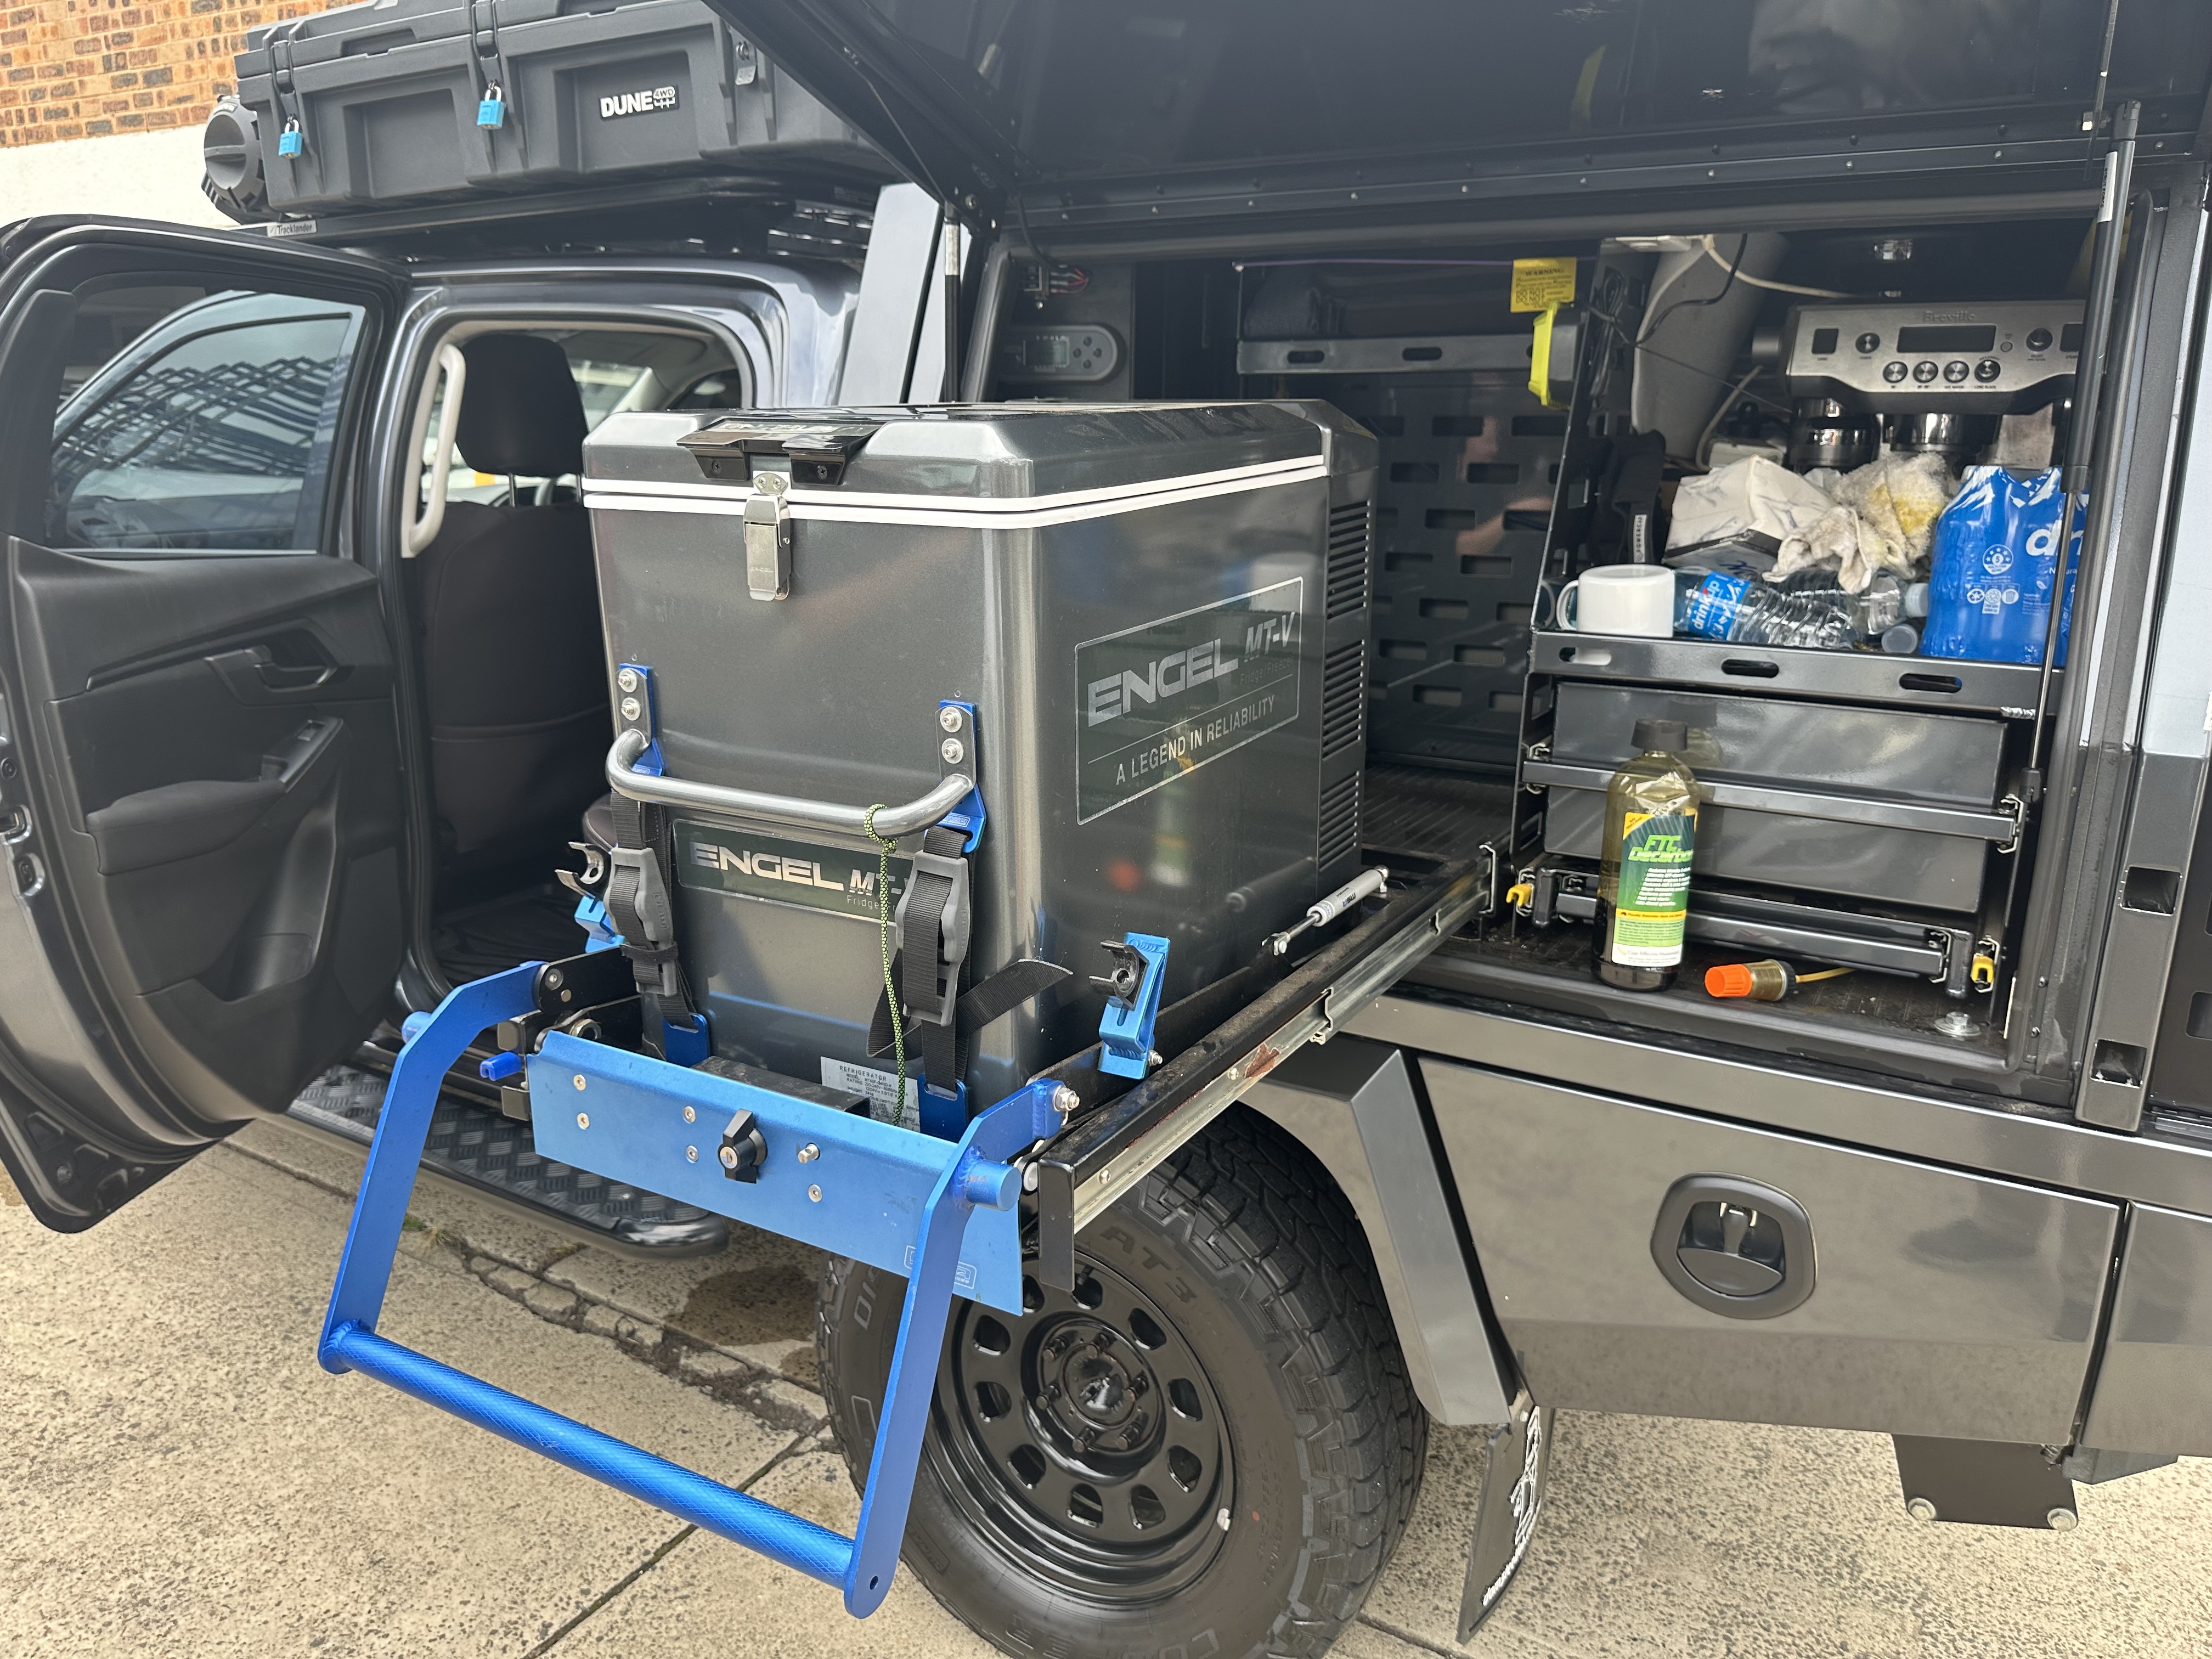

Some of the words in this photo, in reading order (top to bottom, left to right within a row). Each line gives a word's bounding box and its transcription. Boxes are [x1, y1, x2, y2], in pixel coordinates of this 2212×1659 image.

[600, 91, 654, 117] DUNE
[654, 88, 674, 98] 4WD
[277, 223, 313, 235] Tracklander
[1923, 309, 1976, 323] Breville
[1088, 638, 1238, 727] ENGEL
[1245, 611, 1295, 655] MT-V
[1116, 763, 1126, 786] A
[1131, 736, 1186, 778] LEGEND
[1190, 728, 1203, 751] IN
[1207, 695, 1274, 743] RELIABILITY
[1644, 834, 1681, 851] FTC
[690, 841, 844, 891] ENGEL
[839, 1065, 887, 1081] REFRIGERATOR
[1099, 1224, 1198, 1304] AT3
